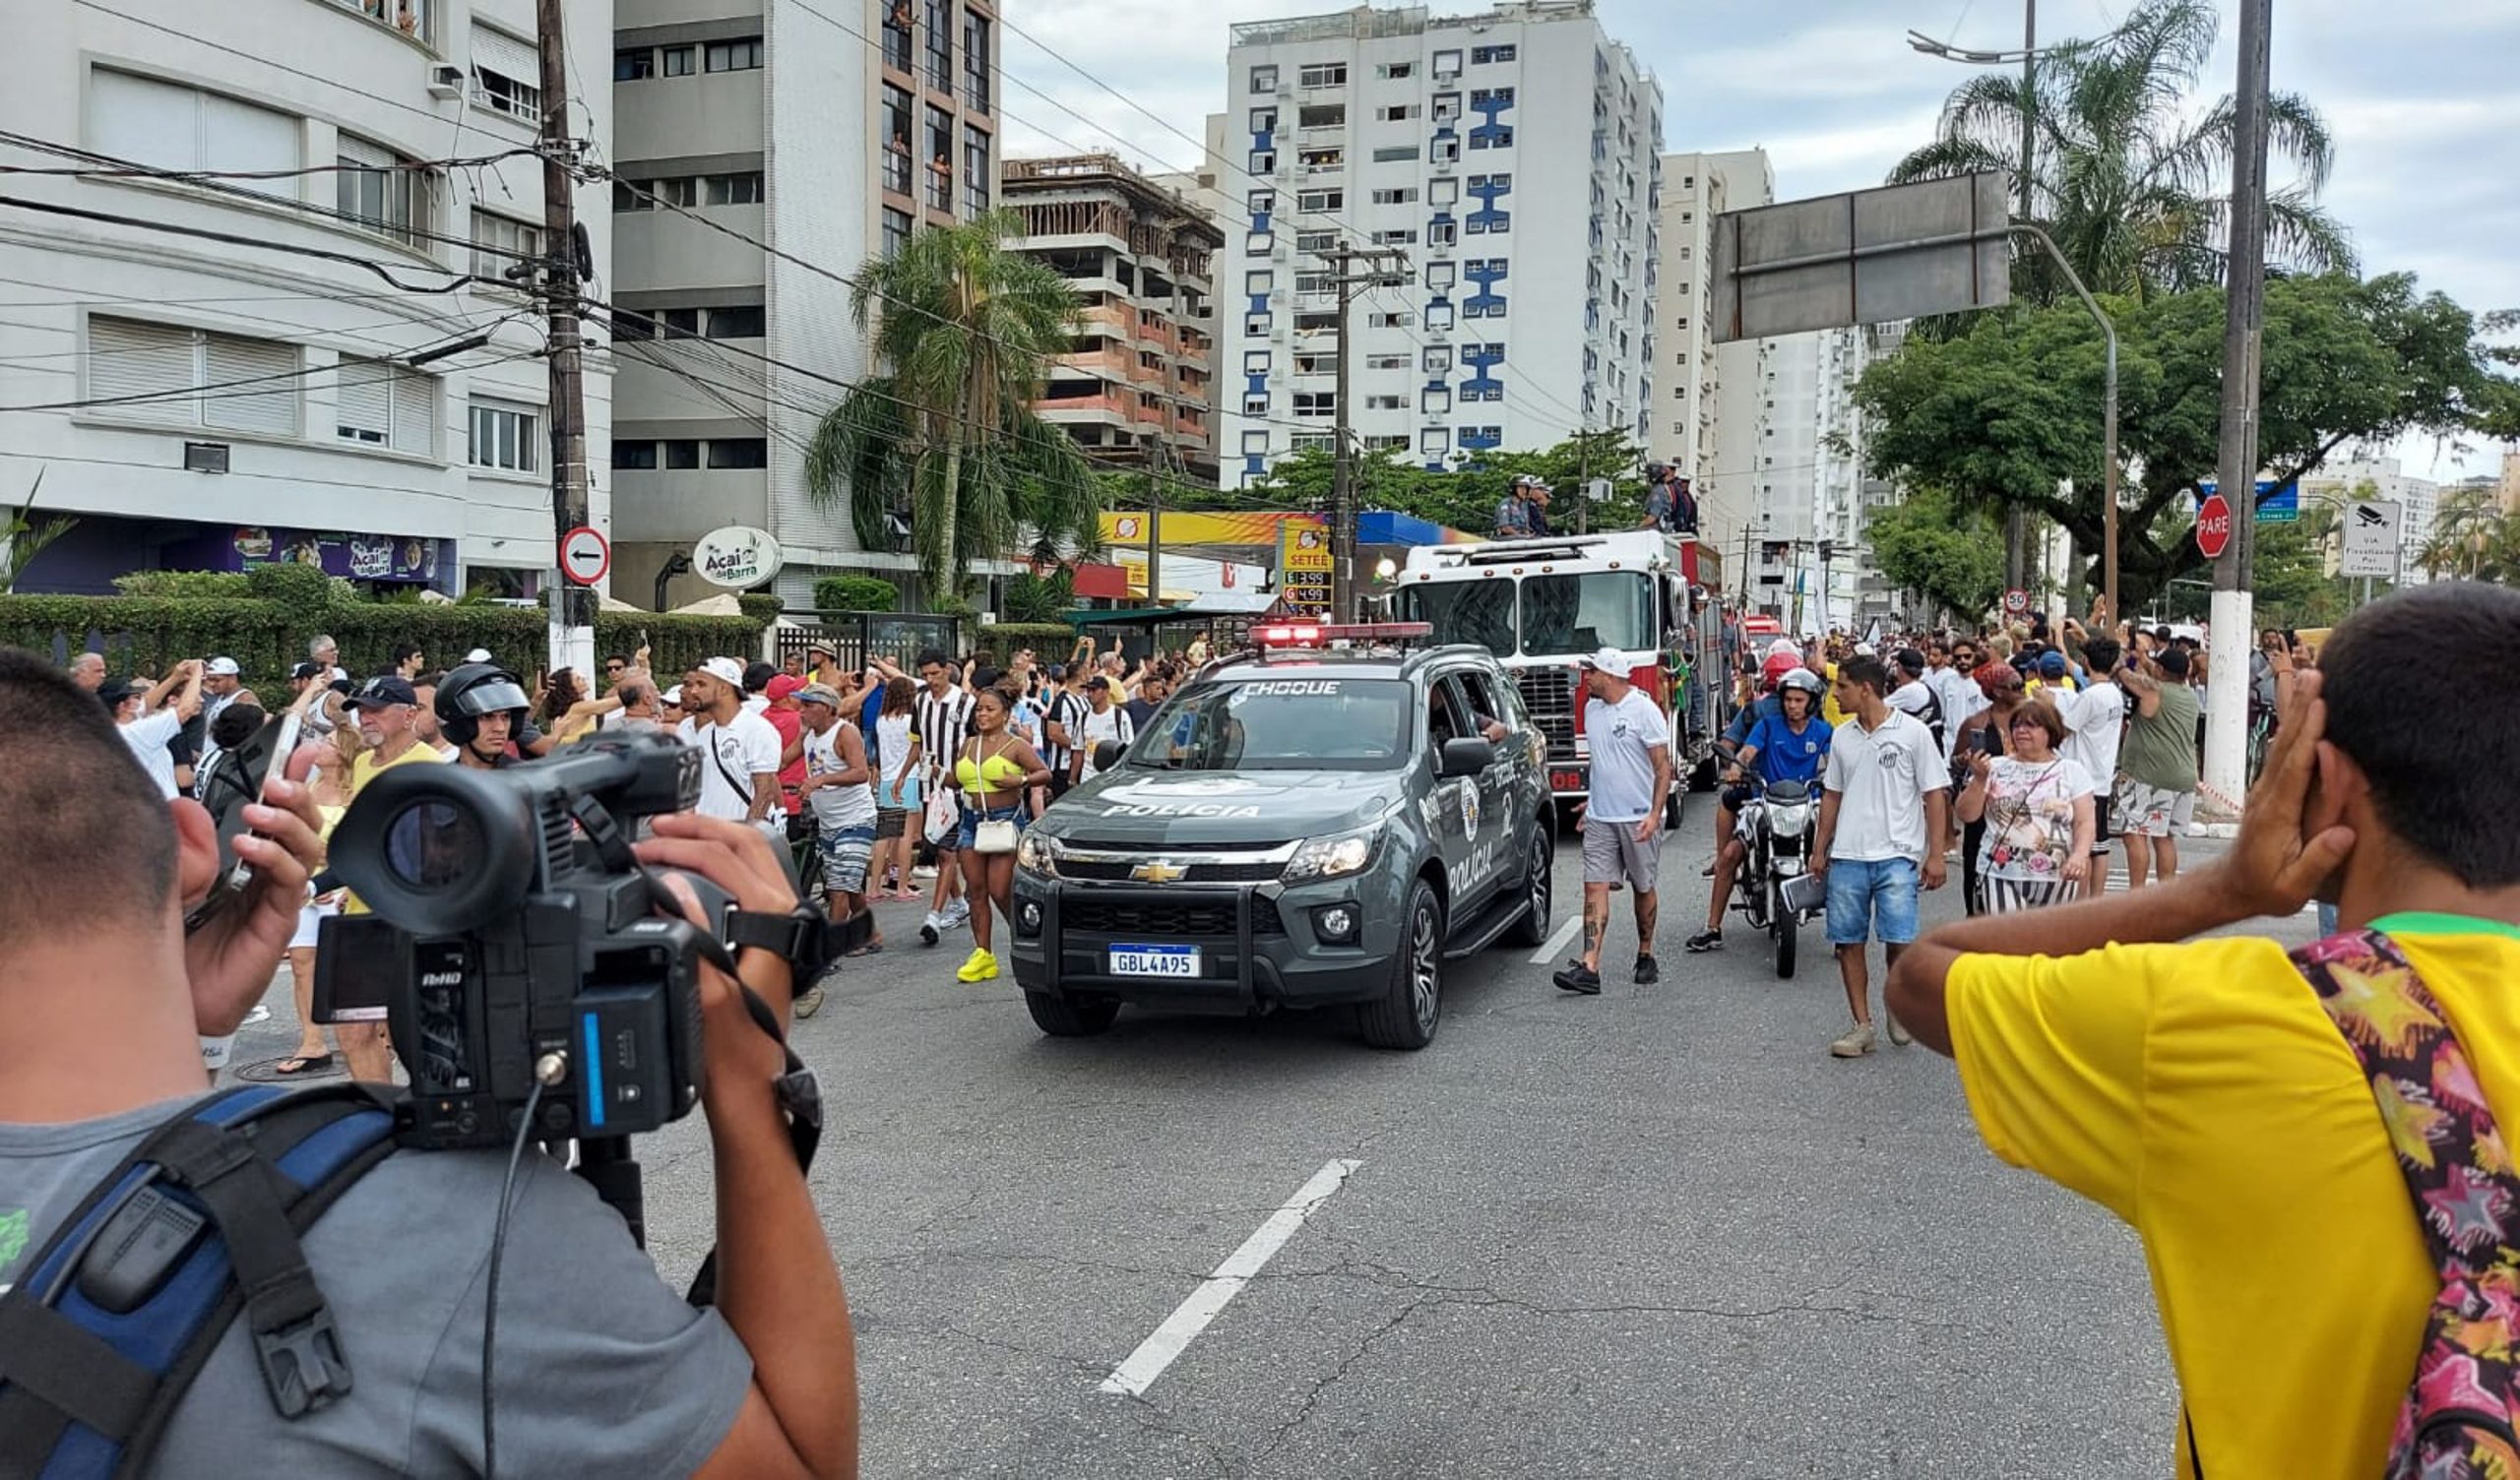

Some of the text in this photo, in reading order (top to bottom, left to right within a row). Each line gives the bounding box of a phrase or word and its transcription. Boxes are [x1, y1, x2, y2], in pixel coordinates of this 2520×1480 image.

[2199, 515, 2229, 536] PARE
[727, 566, 757, 580] Barra
[2009, 593, 2025, 604] 50
[1118, 955, 1190, 973] GBL4A95
